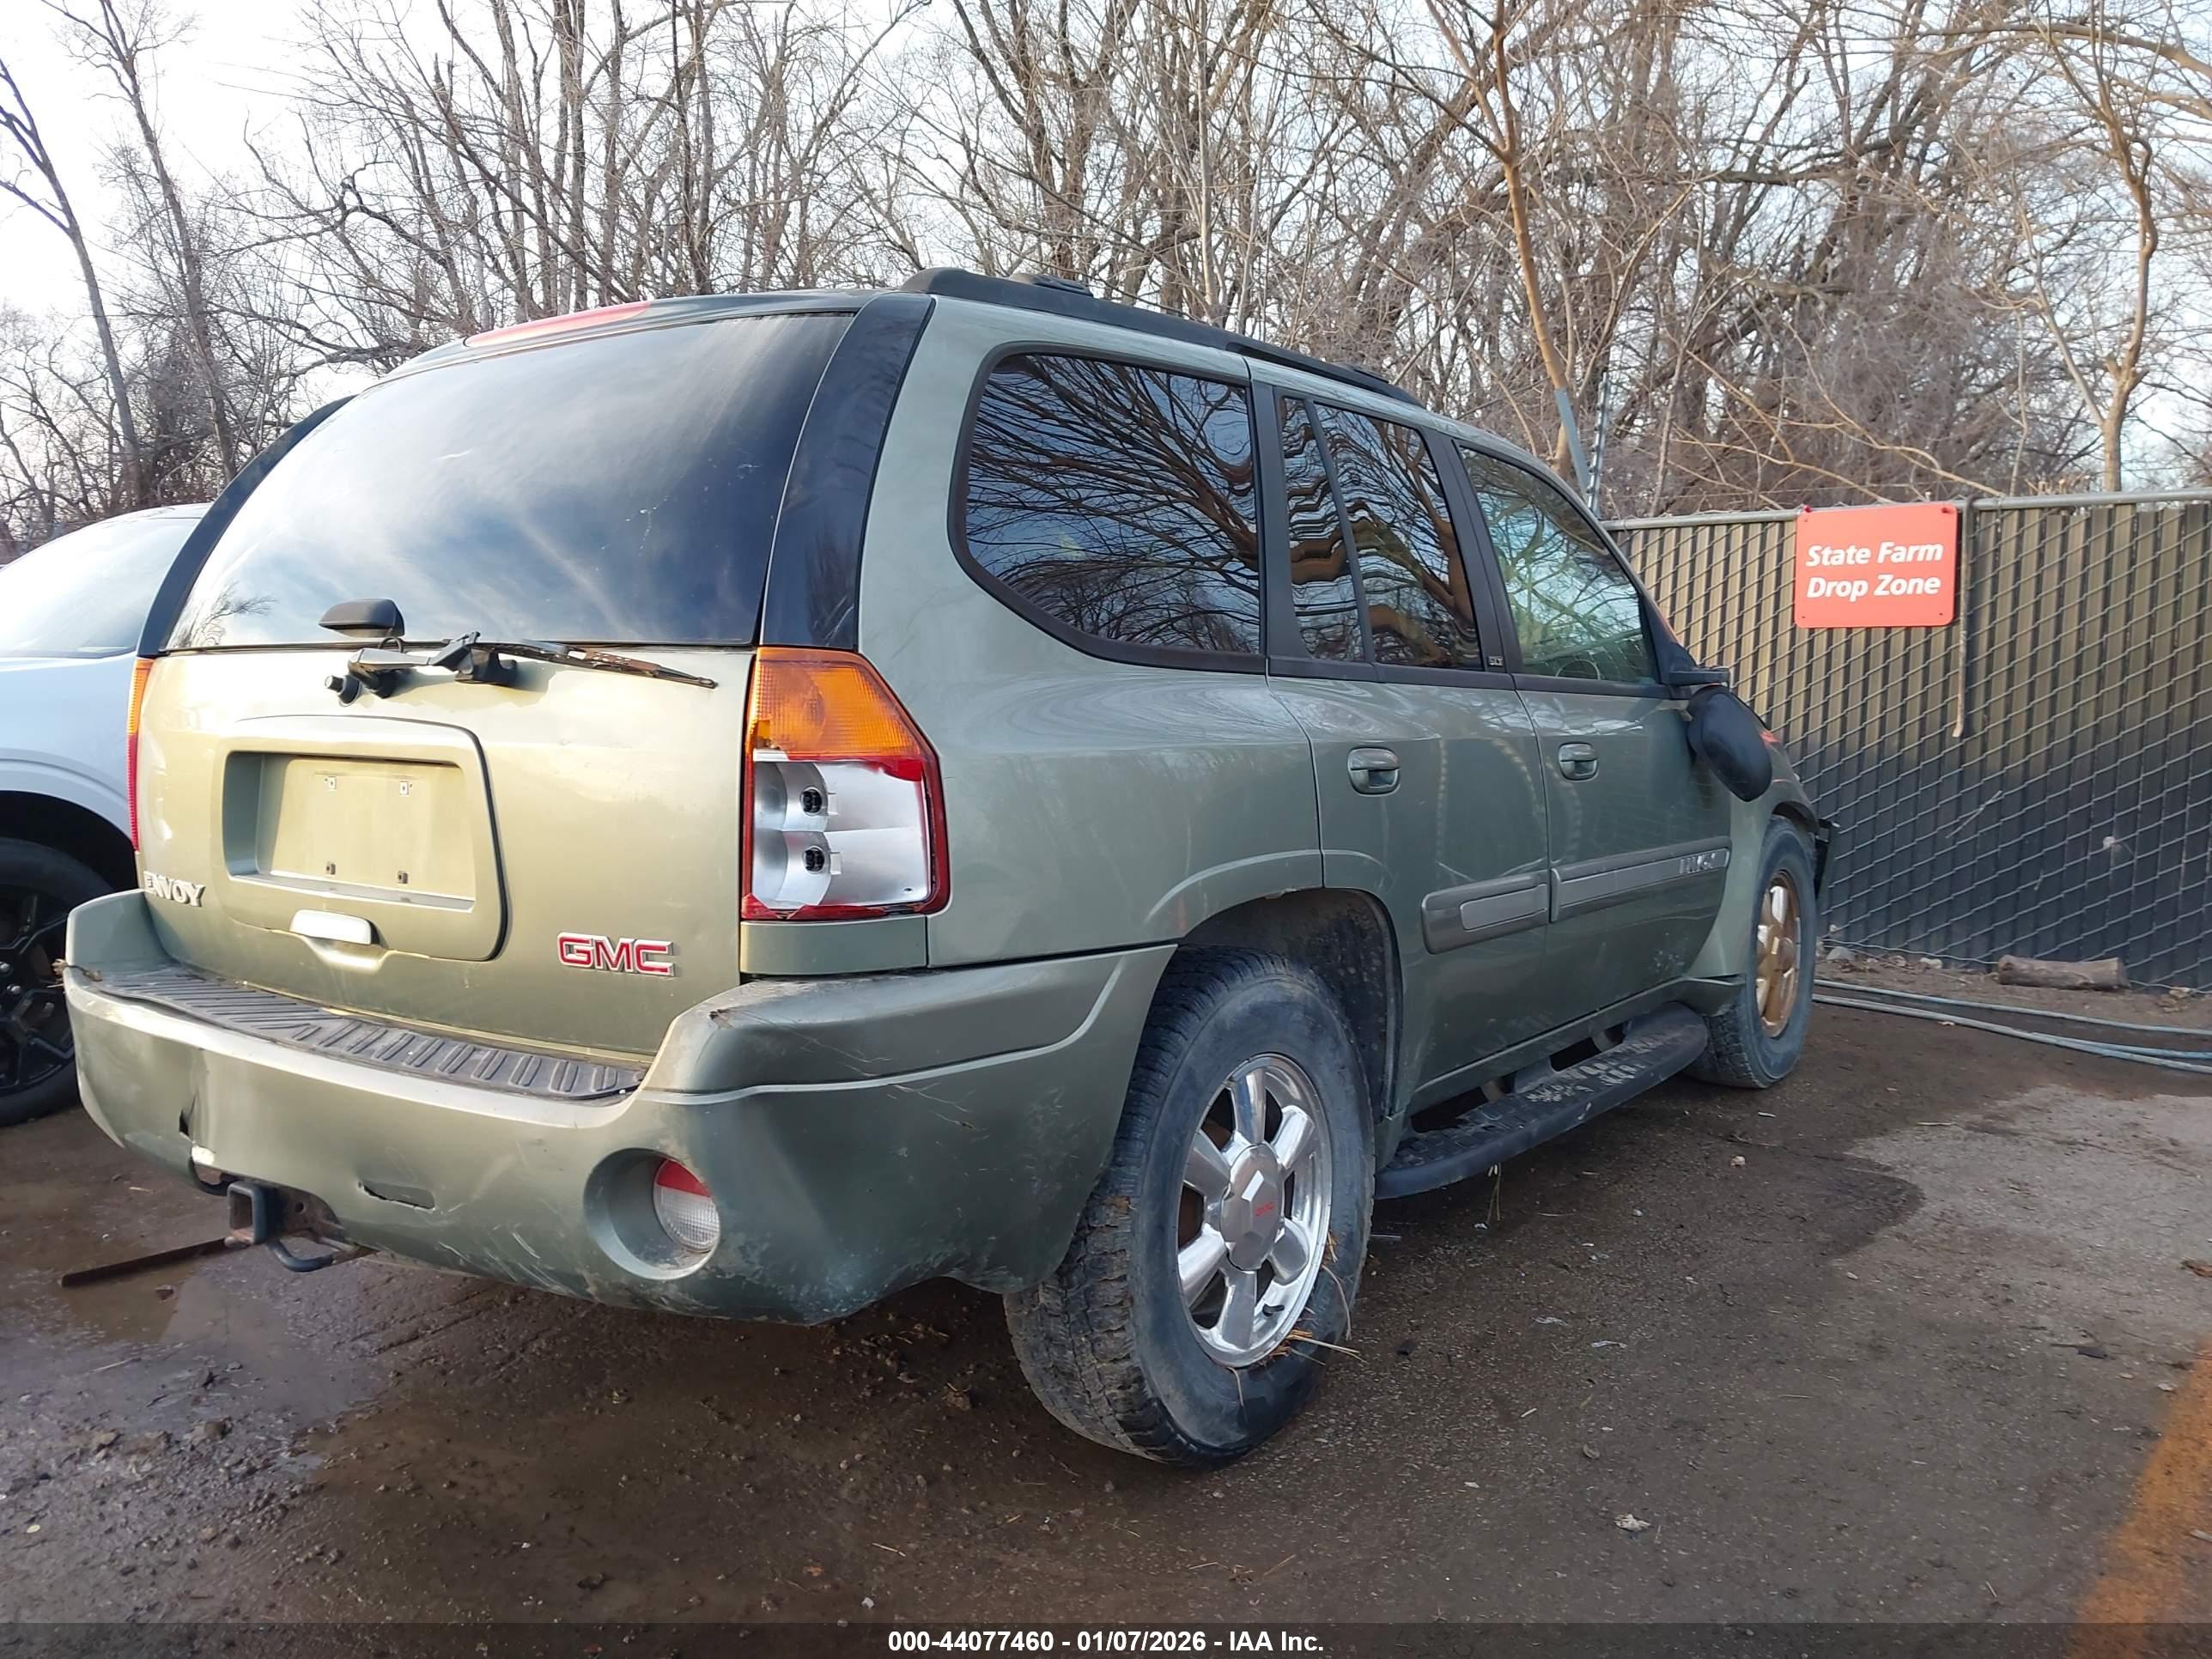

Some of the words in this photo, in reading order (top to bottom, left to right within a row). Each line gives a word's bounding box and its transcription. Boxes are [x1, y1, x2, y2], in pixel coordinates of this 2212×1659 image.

[1805, 544, 1872, 568] State
[1877, 541, 1944, 564] Farm
[1806, 576, 1869, 603] Drop
[1873, 573, 1942, 597] Zone
[143, 870, 206, 908] ENVOY
[557, 932, 675, 976] GMC
